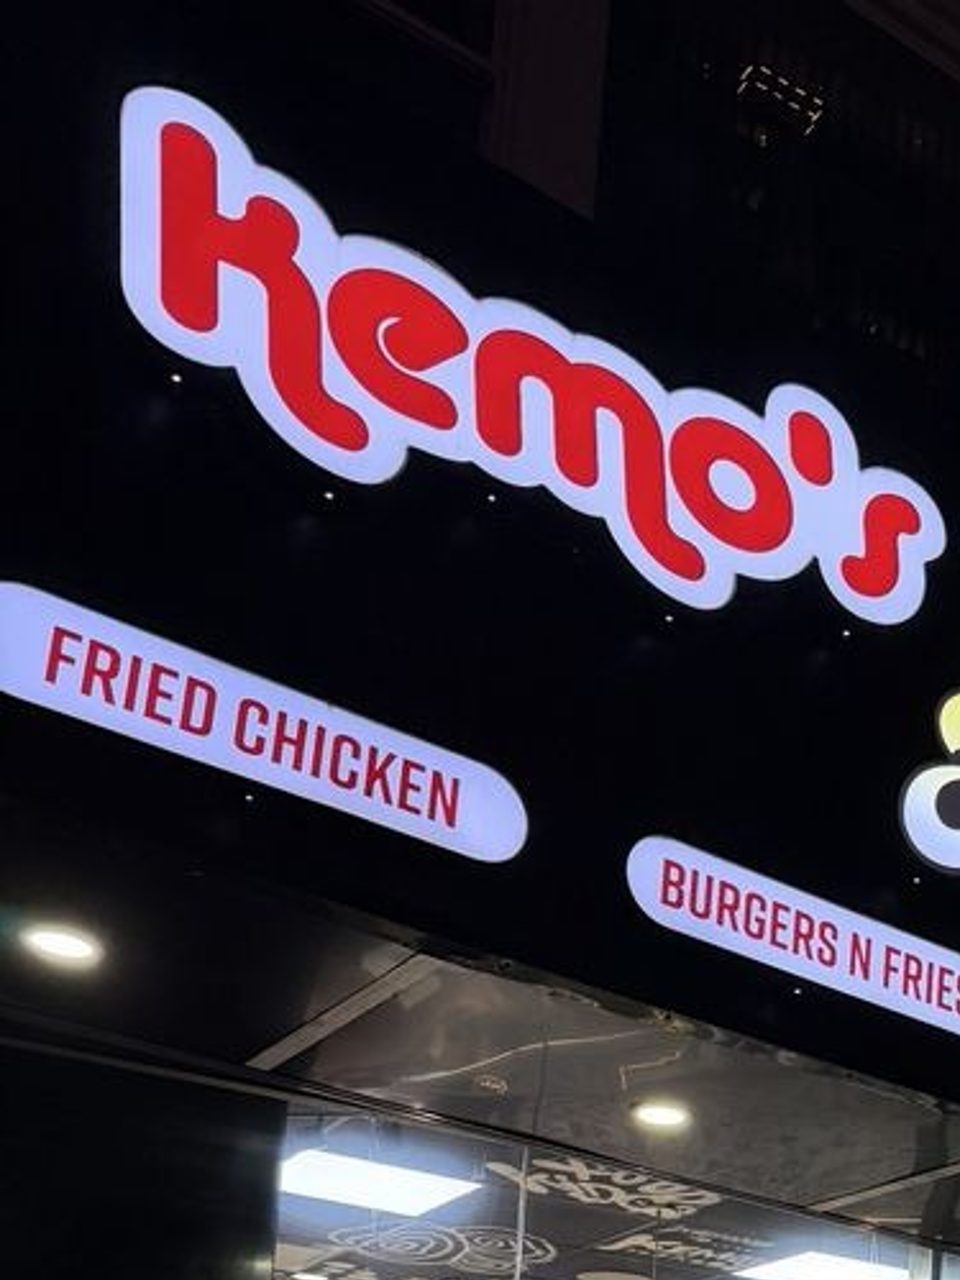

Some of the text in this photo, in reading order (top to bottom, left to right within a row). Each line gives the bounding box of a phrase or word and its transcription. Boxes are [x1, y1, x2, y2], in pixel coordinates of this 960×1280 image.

[44, 625, 462, 830] FRIED CHICKEN
[659, 858, 839, 969] BURGERS
[848, 932, 871, 981] N
